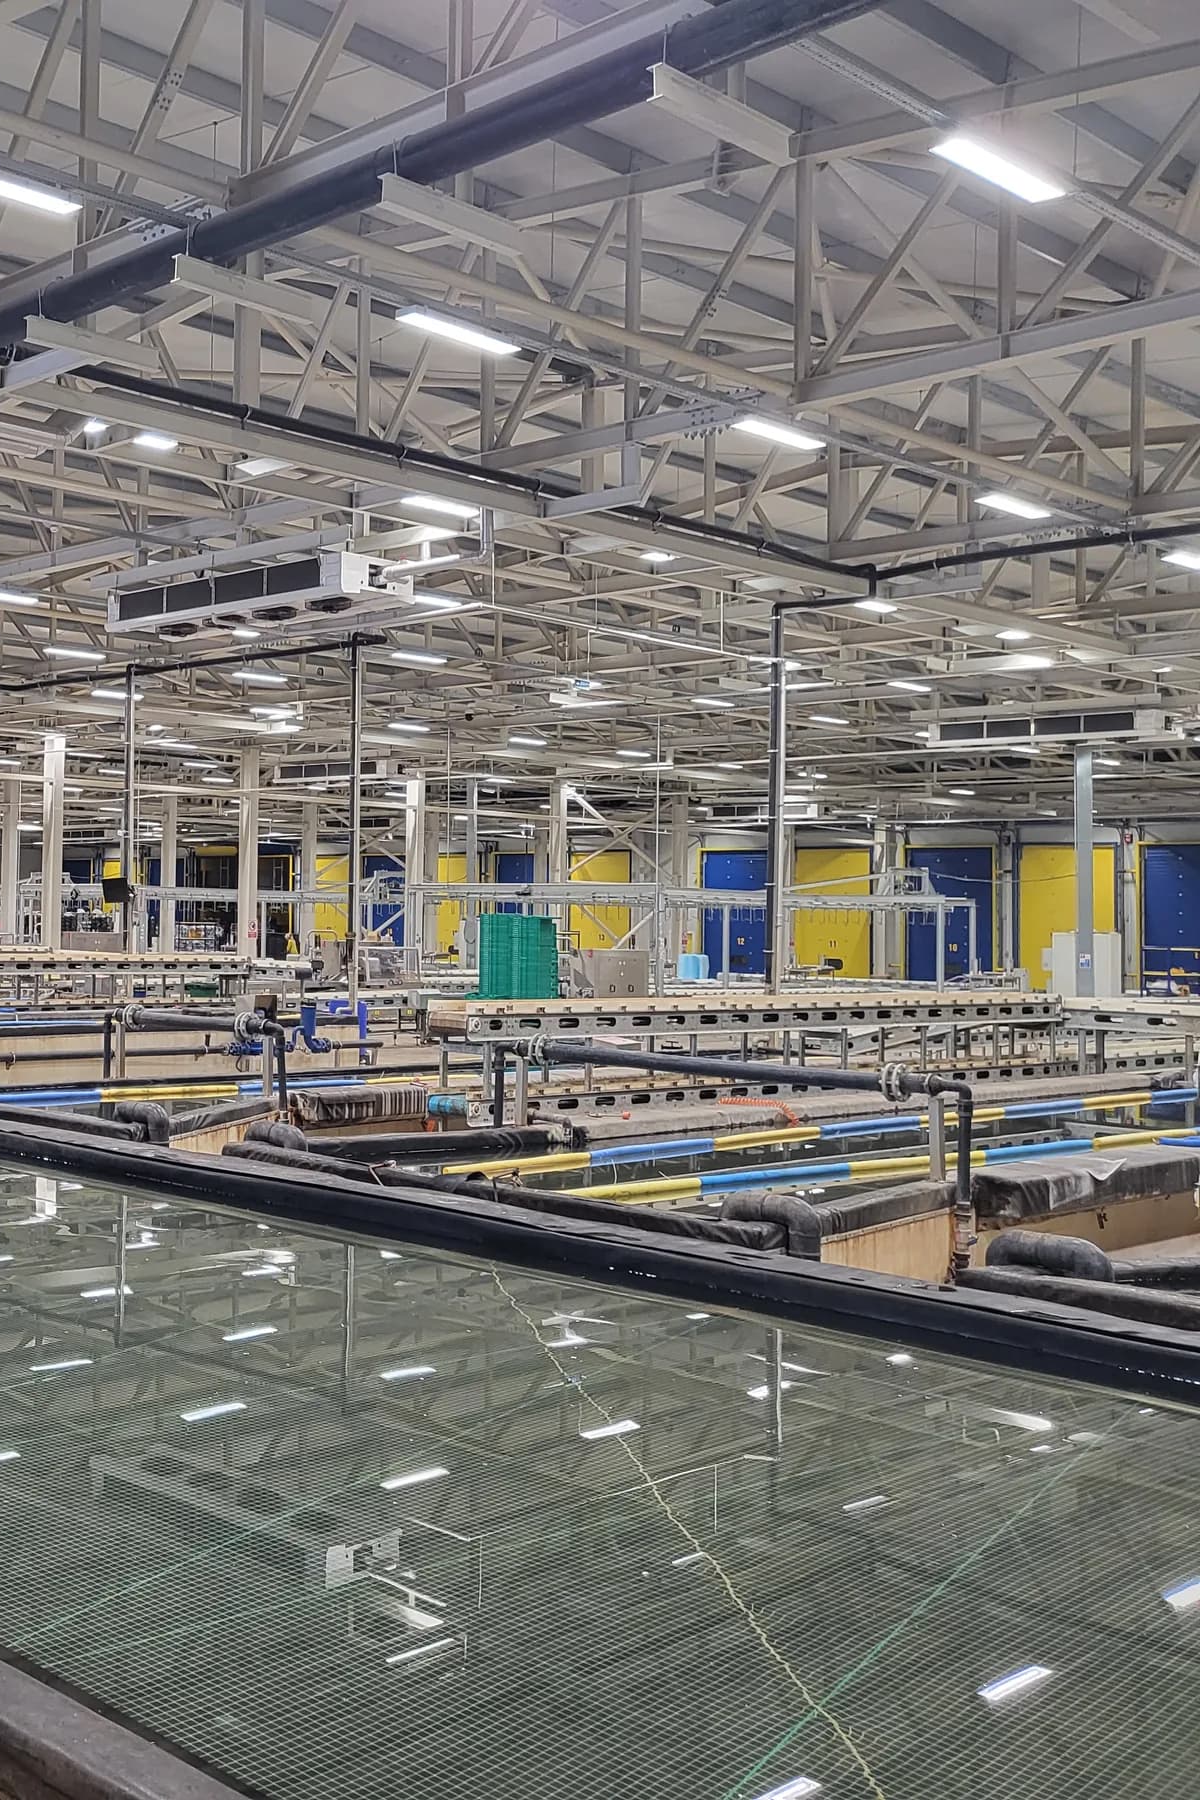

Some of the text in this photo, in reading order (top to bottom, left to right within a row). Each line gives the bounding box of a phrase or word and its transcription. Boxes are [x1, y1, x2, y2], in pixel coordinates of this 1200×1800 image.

[736, 937, 745, 945] 12
[829, 940, 837, 948] 11
[948, 943, 958, 951] 10
